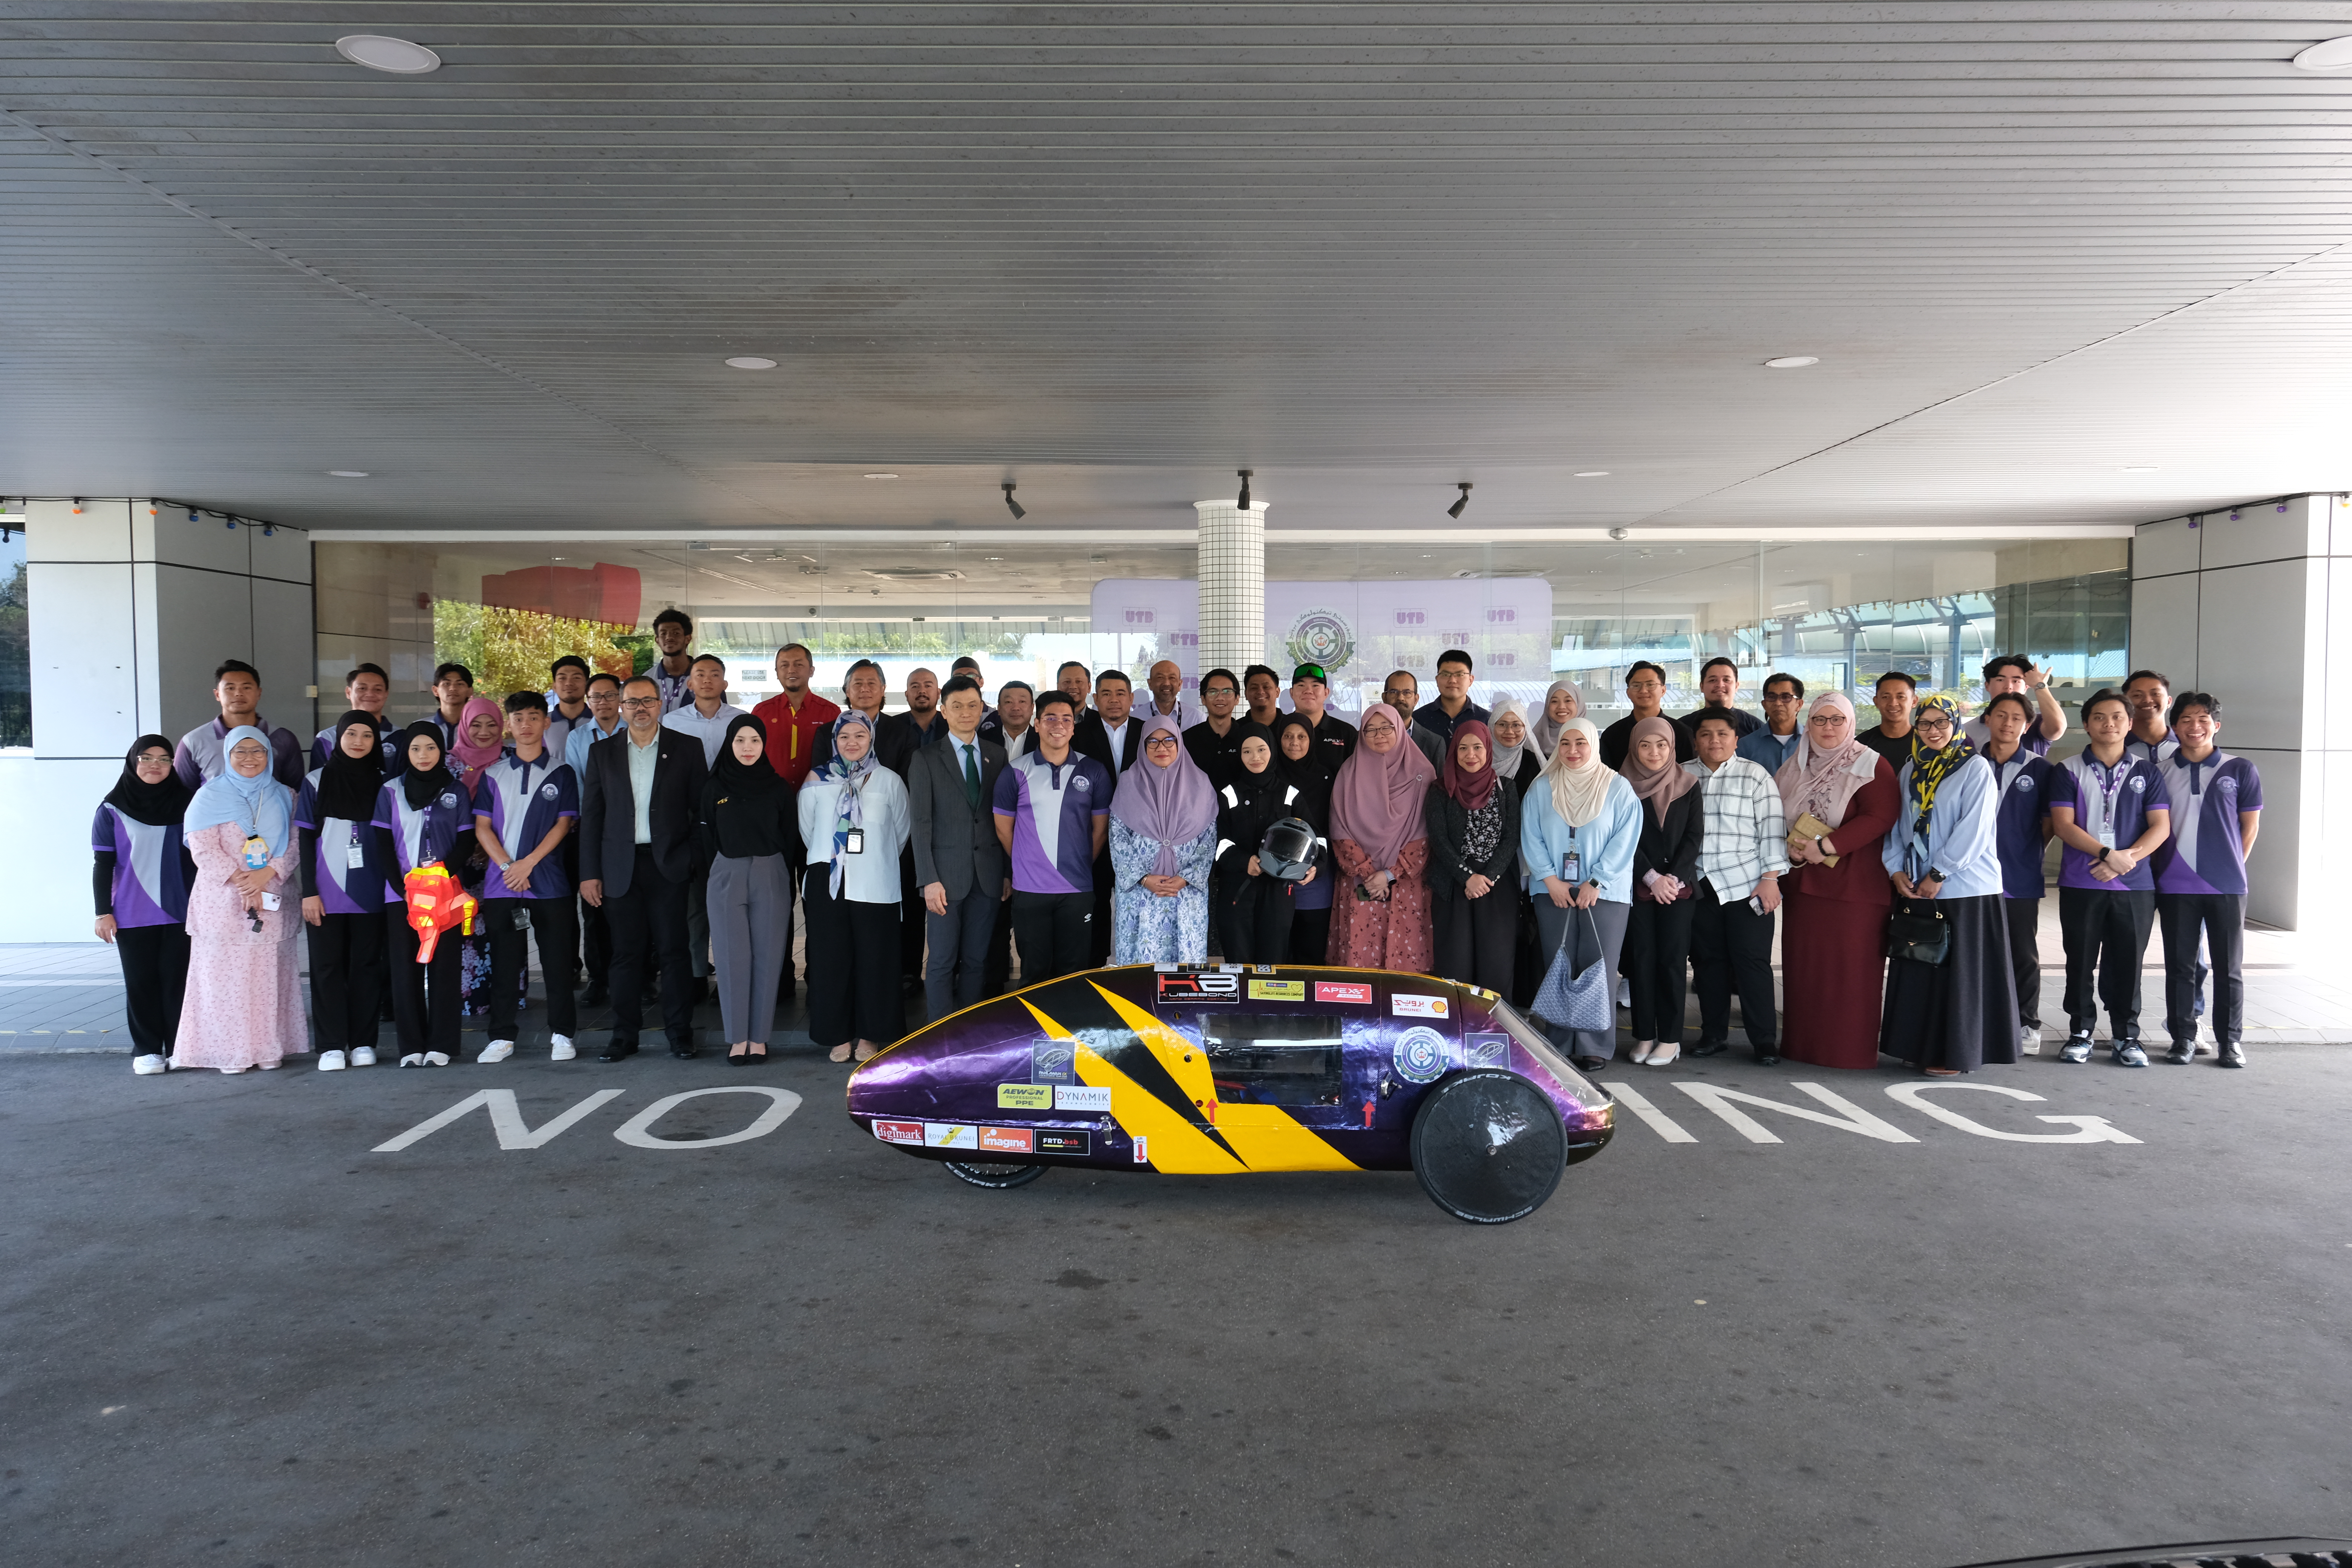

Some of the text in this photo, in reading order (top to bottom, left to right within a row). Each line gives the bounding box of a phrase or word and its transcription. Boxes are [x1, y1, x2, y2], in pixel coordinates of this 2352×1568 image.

[1125, 611, 1154, 623] UTB
[1397, 612, 1425, 624] UTB
[1487, 609, 1515, 622] UTB
[1170, 634, 1199, 646] UTB
[1442, 632, 1470, 645] UTB
[1397, 655, 1425, 668] UTB
[1487, 653, 1515, 666] UTB
[1182, 677, 1199, 689] TB
[1159, 974, 1237, 992] KB
[1453, 1073, 1511, 1087] KOJAK
[1057, 1091, 1109, 1102] DYNAMIK
[370, 1086, 803, 1152] NO
[877, 1128, 922, 1140] digimark
[984, 1135, 1026, 1148] imagine
[945, 1162, 997, 1188] KOJAK
[1455, 1205, 1533, 1223] SCHWALBE
